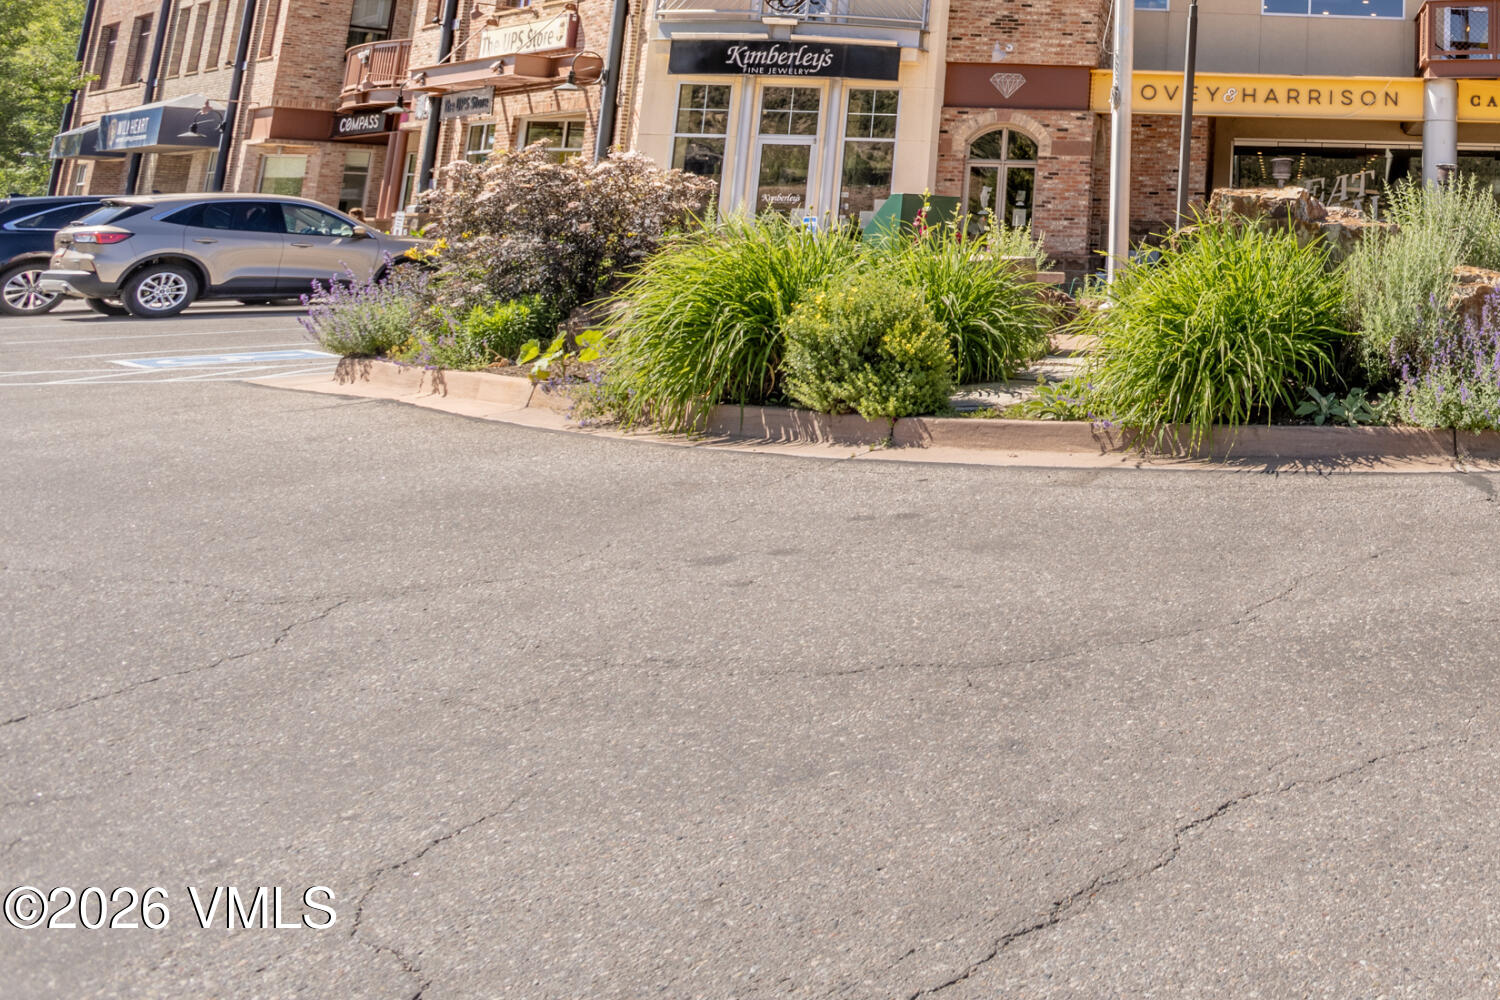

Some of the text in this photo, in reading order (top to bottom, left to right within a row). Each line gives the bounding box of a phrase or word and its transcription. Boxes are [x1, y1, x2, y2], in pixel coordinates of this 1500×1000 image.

[503, 29, 525, 51] UPS
[526, 28, 554, 50] Store
[726, 44, 834, 74] Kimberley's
[743, 66, 810, 76] FINE JEWELRY
[339, 113, 380, 133] COMPASS
